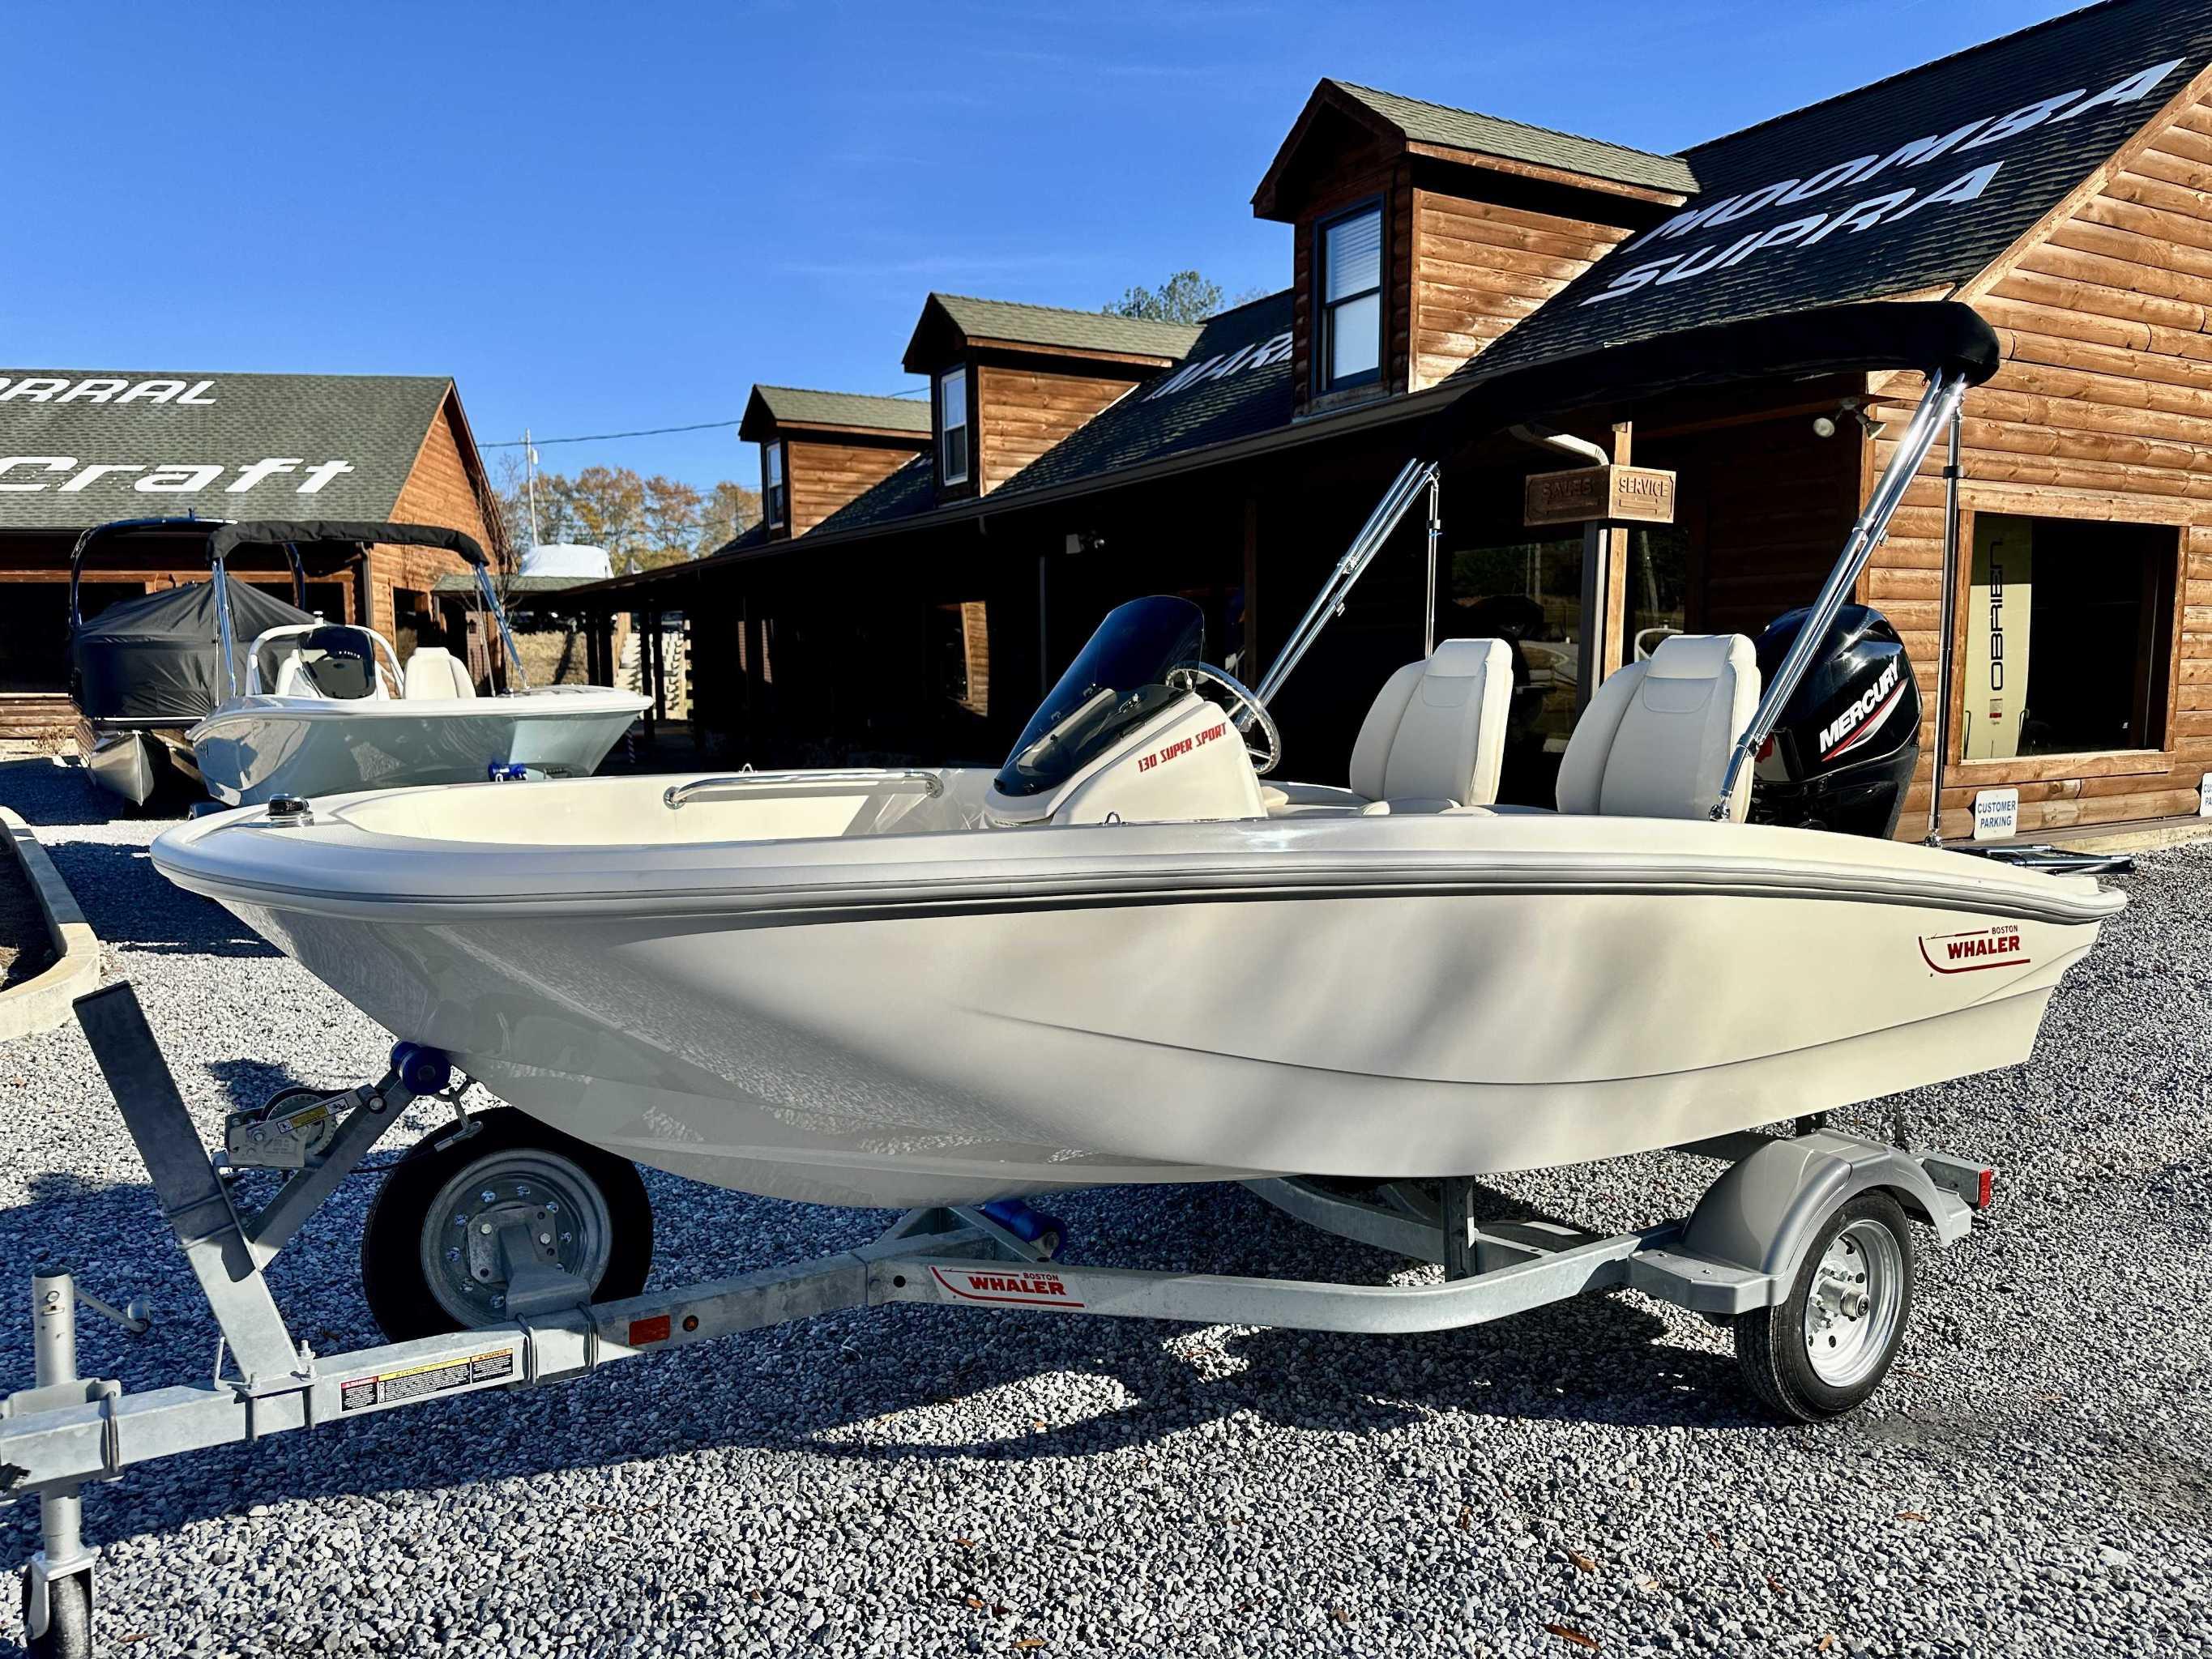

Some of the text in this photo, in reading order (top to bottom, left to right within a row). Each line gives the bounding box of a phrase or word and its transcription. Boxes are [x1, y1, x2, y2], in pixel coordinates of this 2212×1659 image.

[1621, 57, 2186, 253] MOOMBA
[1578, 161, 2004, 306] SUPRA
[0, 377, 216, 405] RRAL
[0, 456, 356, 493] Craft
[1542, 477, 1594, 499] SALES
[1619, 476, 1669, 497] SERVICE
[1819, 655, 1900, 753] MERCURY
[1137, 722, 1227, 772] 130 SUPER SPORT
[1977, 800, 2017, 814] CUSTOMER
[1980, 815, 2012, 829] PARKING
[1991, 924, 2019, 935] BOSTON
[1946, 935, 2021, 960] WHALER
[967, 1276, 1066, 1296] WHALER
[1023, 1272, 1060, 1282] BOSTON
